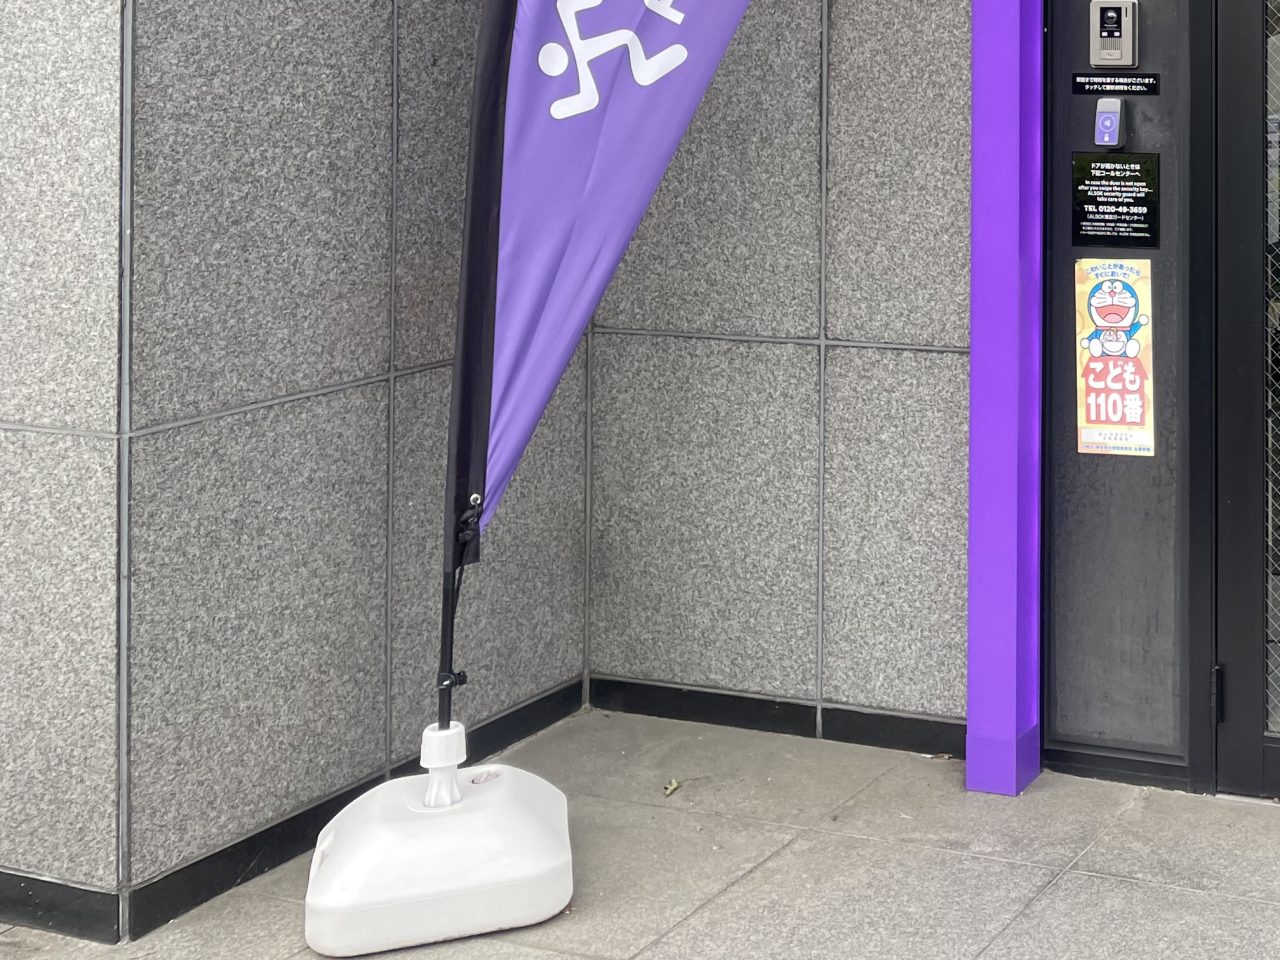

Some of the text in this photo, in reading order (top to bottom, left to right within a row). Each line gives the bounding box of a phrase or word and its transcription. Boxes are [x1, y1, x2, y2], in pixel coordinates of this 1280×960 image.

[1087, 360, 1141, 392] こども
[1087, 392, 1143, 424] 110番
